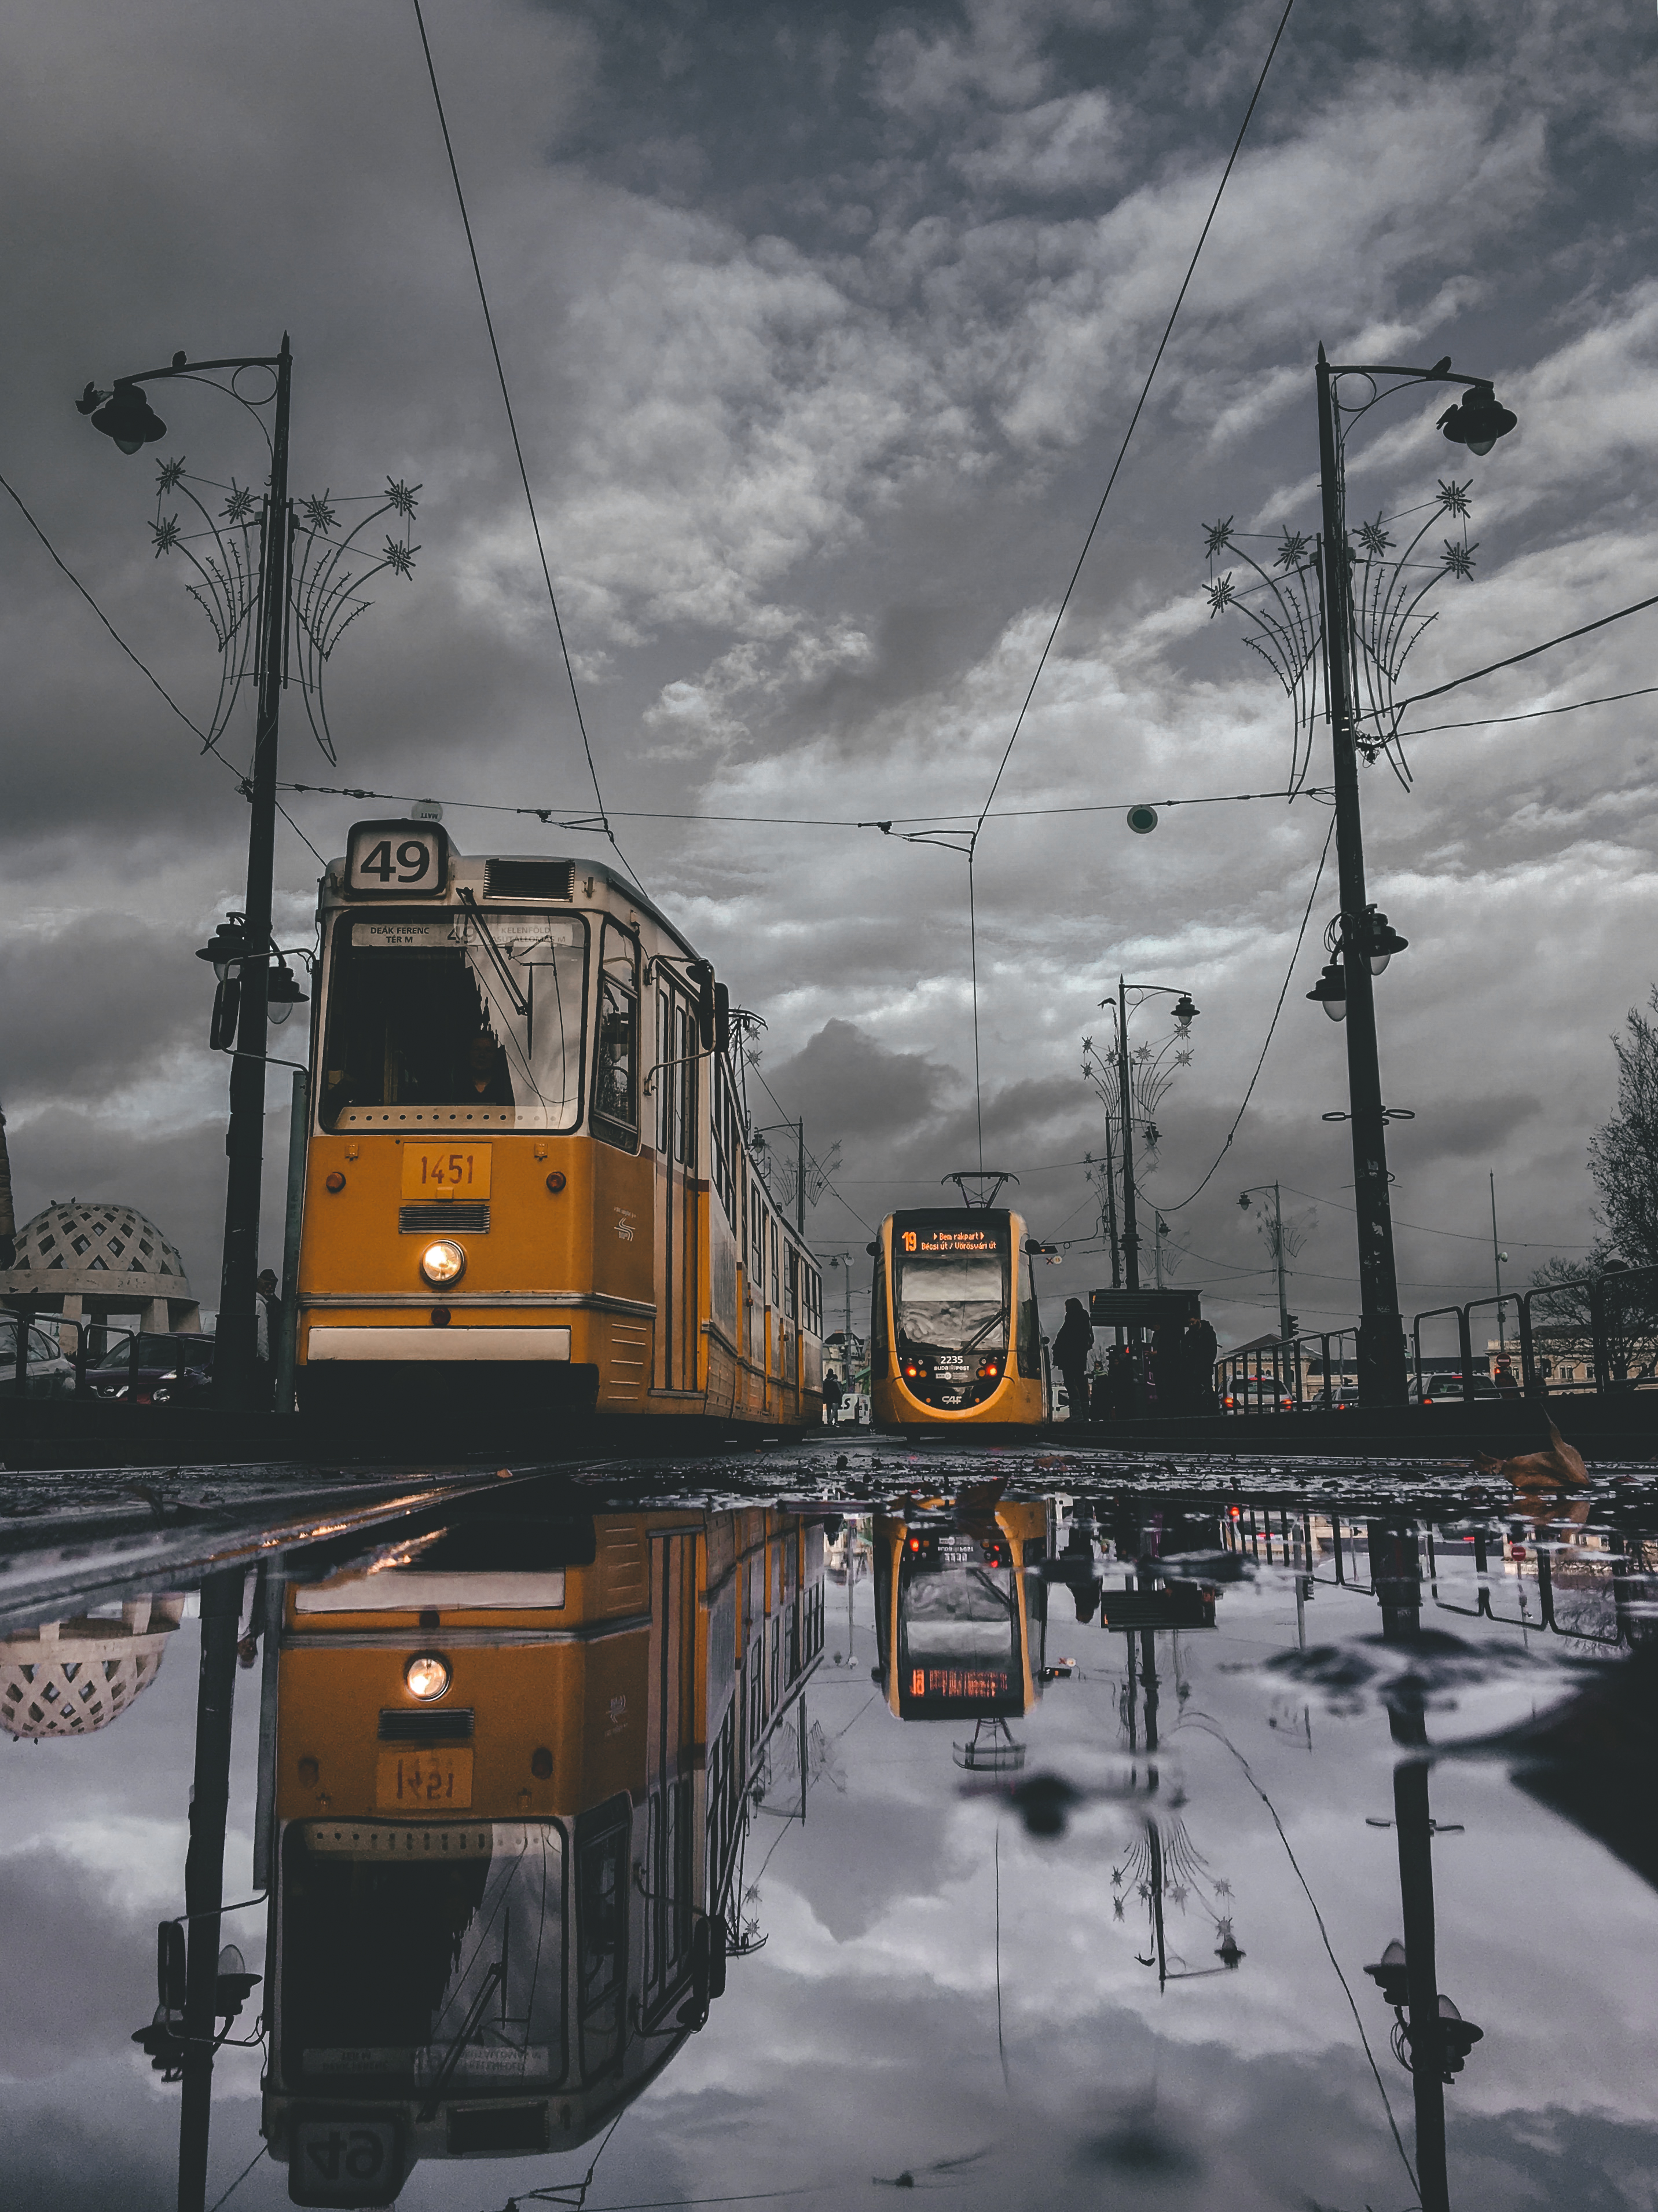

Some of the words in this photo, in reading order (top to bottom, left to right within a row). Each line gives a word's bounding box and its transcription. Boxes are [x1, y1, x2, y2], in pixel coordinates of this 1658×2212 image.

[360, 840, 430, 883] 49
[371, 925, 394, 934] DEÁK
[386, 935, 402, 943] TÉR
[421, 1155, 474, 1184] 1451
[939, 1232, 952, 1240] Bem
[953, 1232, 979, 1240] rakpart
[901, 1232, 917, 1251] 19
[921, 1241, 939, 1250] Bécsi
[940, 1241, 948, 1250] út
[989, 1241, 996, 1249] út
[940, 1356, 963, 1364] 2235
